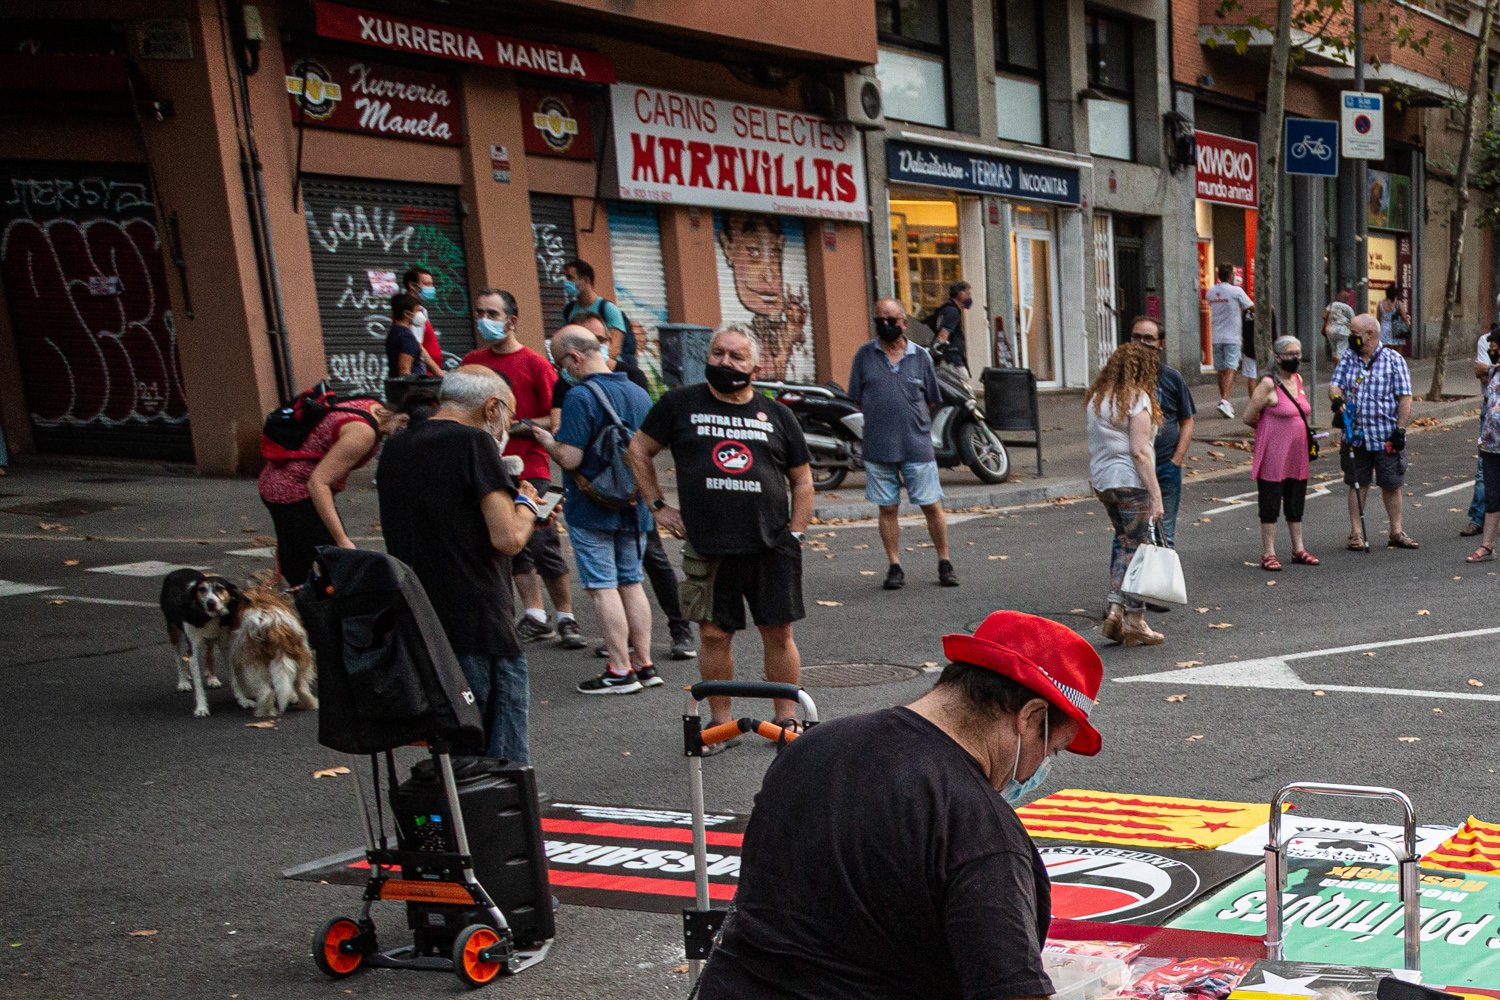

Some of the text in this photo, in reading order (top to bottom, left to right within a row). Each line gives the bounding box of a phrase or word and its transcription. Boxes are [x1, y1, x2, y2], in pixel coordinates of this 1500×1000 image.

[358, 15, 586, 77] XURRERIA MANELA
[349, 62, 450, 107] Xurreria
[354, 98, 453, 141] Manela
[633, 88, 719, 134] CARNS
[732, 104, 847, 153] SELECTES
[969, 158, 1013, 190] TERRAS
[1018, 166, 1069, 197] INCOGNITAS
[1196, 145, 1253, 183] KIWOKO
[1198, 179, 1254, 202] mundo animal
[690, 413, 775, 433] CONTRA EL VIRUS
[697, 425, 769, 442] DE LA CORONA
[706, 476, 762, 493] REPÚBLICA
